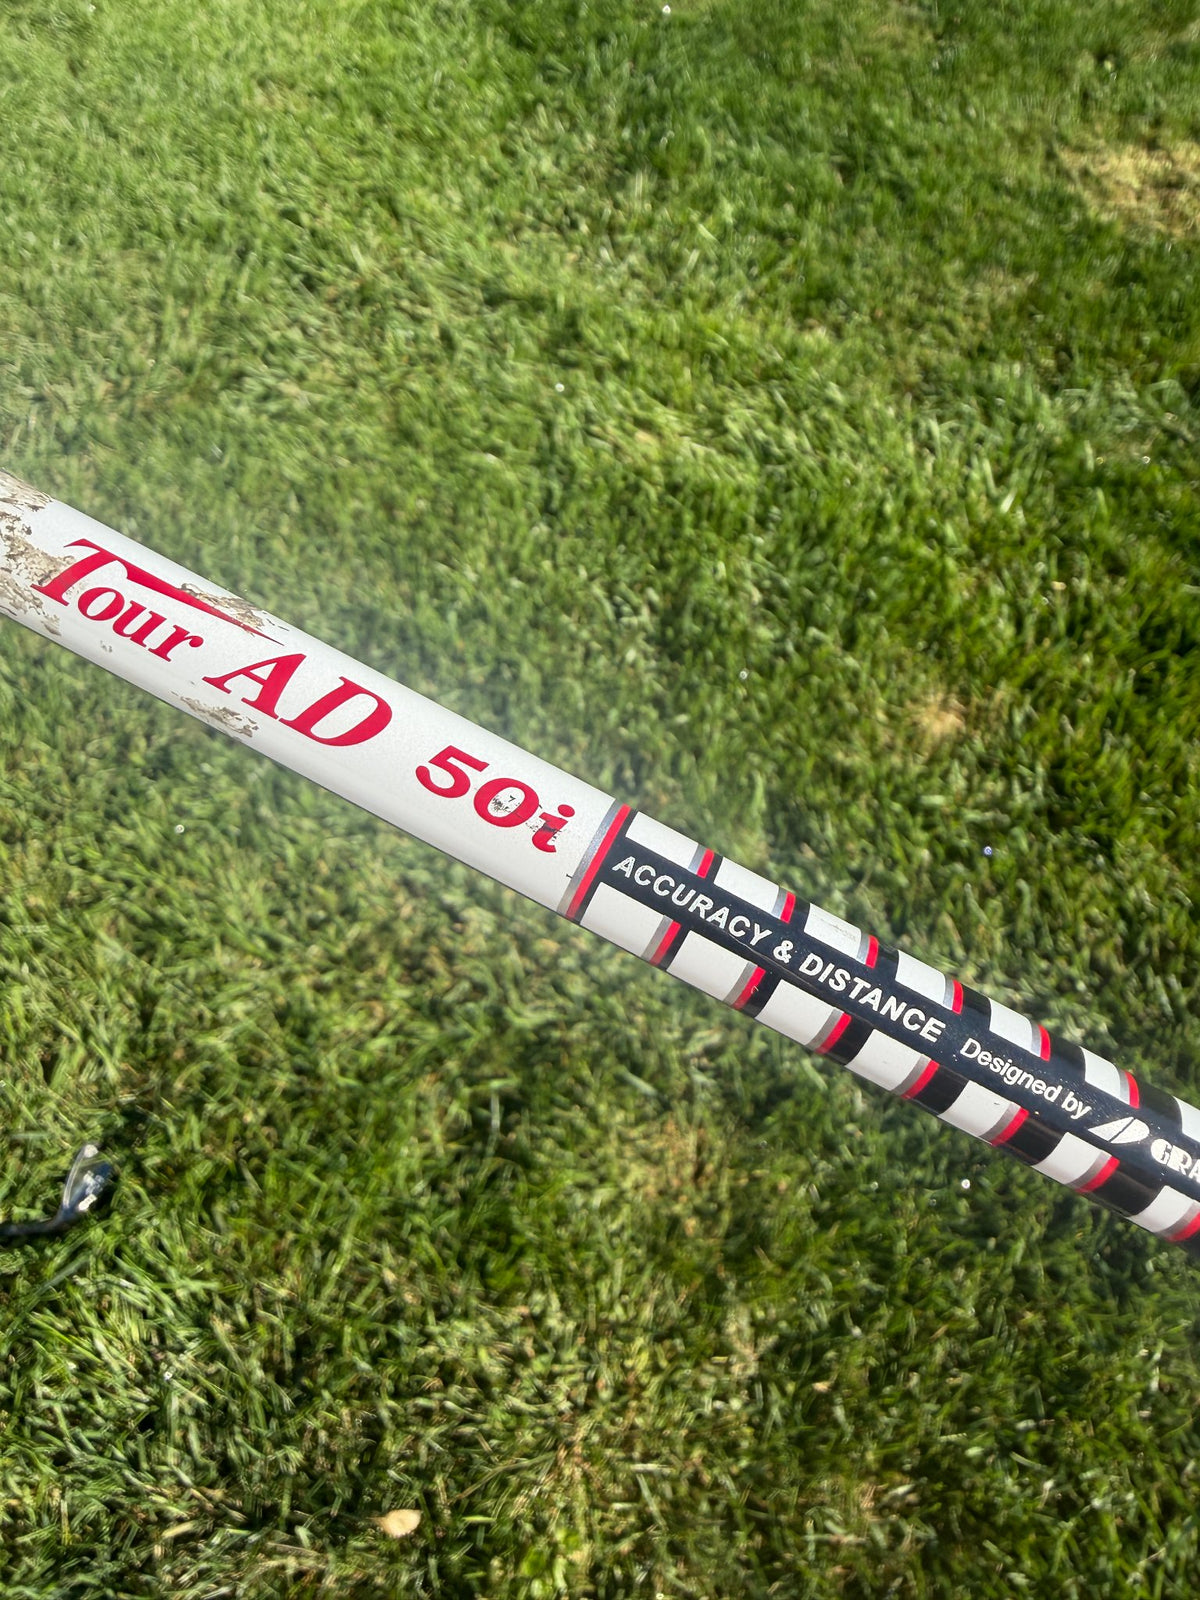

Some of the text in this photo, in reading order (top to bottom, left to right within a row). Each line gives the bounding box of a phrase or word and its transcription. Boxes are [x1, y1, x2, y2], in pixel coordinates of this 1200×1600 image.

[31, 539, 575, 852] Tour AD 50i
[612, 856, 773, 947] ACCURACY
[773, 940, 794, 964] &
[800, 952, 946, 1043] DISTANCE
[960, 1037, 1063, 1103] Designed
[1061, 1090, 1092, 1120] by
